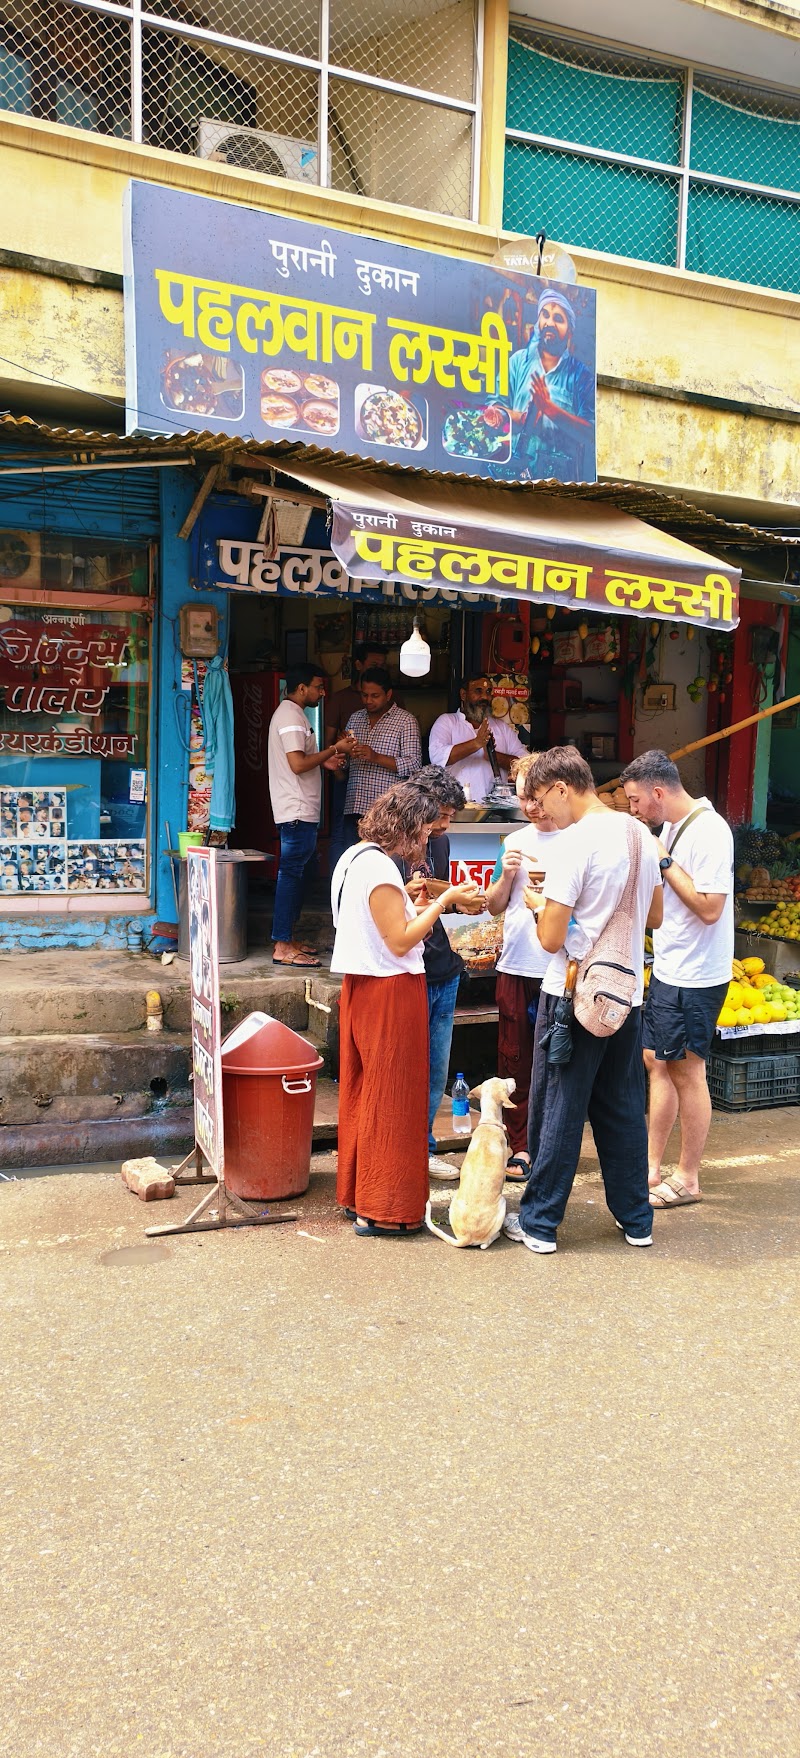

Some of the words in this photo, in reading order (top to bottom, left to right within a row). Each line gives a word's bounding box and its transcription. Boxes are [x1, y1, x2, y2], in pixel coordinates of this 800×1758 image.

[268, 239, 337, 280] पुरानी
[355, 257, 421, 297] दुकान
[503, 256, 529, 267] TATA
[154, 268, 377, 371] पहलवान
[387, 311, 513, 397] लस्सी
[351, 511, 399, 530] पुरानी
[410, 520, 458, 539] दुकान
[350, 530, 593, 599] पहलवान
[604, 570, 738, 622] लस्सी
[42, 613, 86, 629] अन्नपूर्णा
